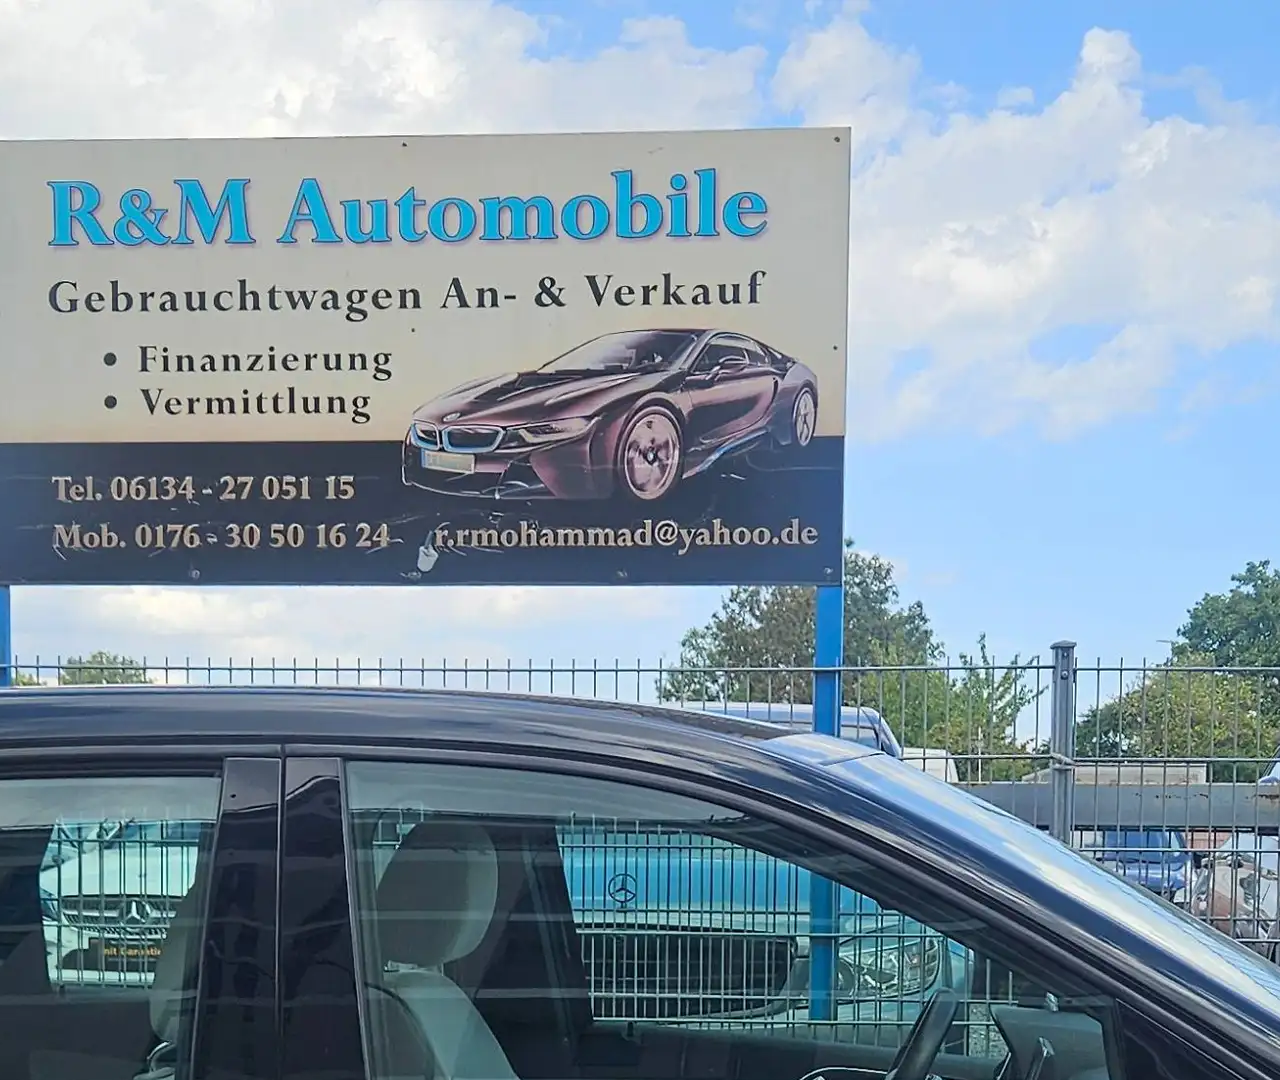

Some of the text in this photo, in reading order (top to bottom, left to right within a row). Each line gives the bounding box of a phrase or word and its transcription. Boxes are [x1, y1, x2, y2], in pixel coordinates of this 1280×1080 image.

[47, 168, 768, 246] R&M Automobile
[48, 270, 767, 322] Gebrauchtwagen An- & Verkauf
[138, 346, 392, 381] Finanzierung
[140, 387, 370, 424] Vermittlung
[51, 476, 102, 501] Tel.
[110, 476, 195, 500] 06134
[220, 476, 253, 500] 27
[262, 476, 311, 500] 051
[325, 476, 355, 500] 15
[53, 522, 126, 549] Mob.
[135, 522, 200, 549] 0176
[225, 522, 261, 549] 30
[270, 522, 304, 549] 50
[317, 522, 347, 549] 16
[355, 522, 391, 549] 24
[434, 519, 819, 555] r.rmohammad@yahoo.de
